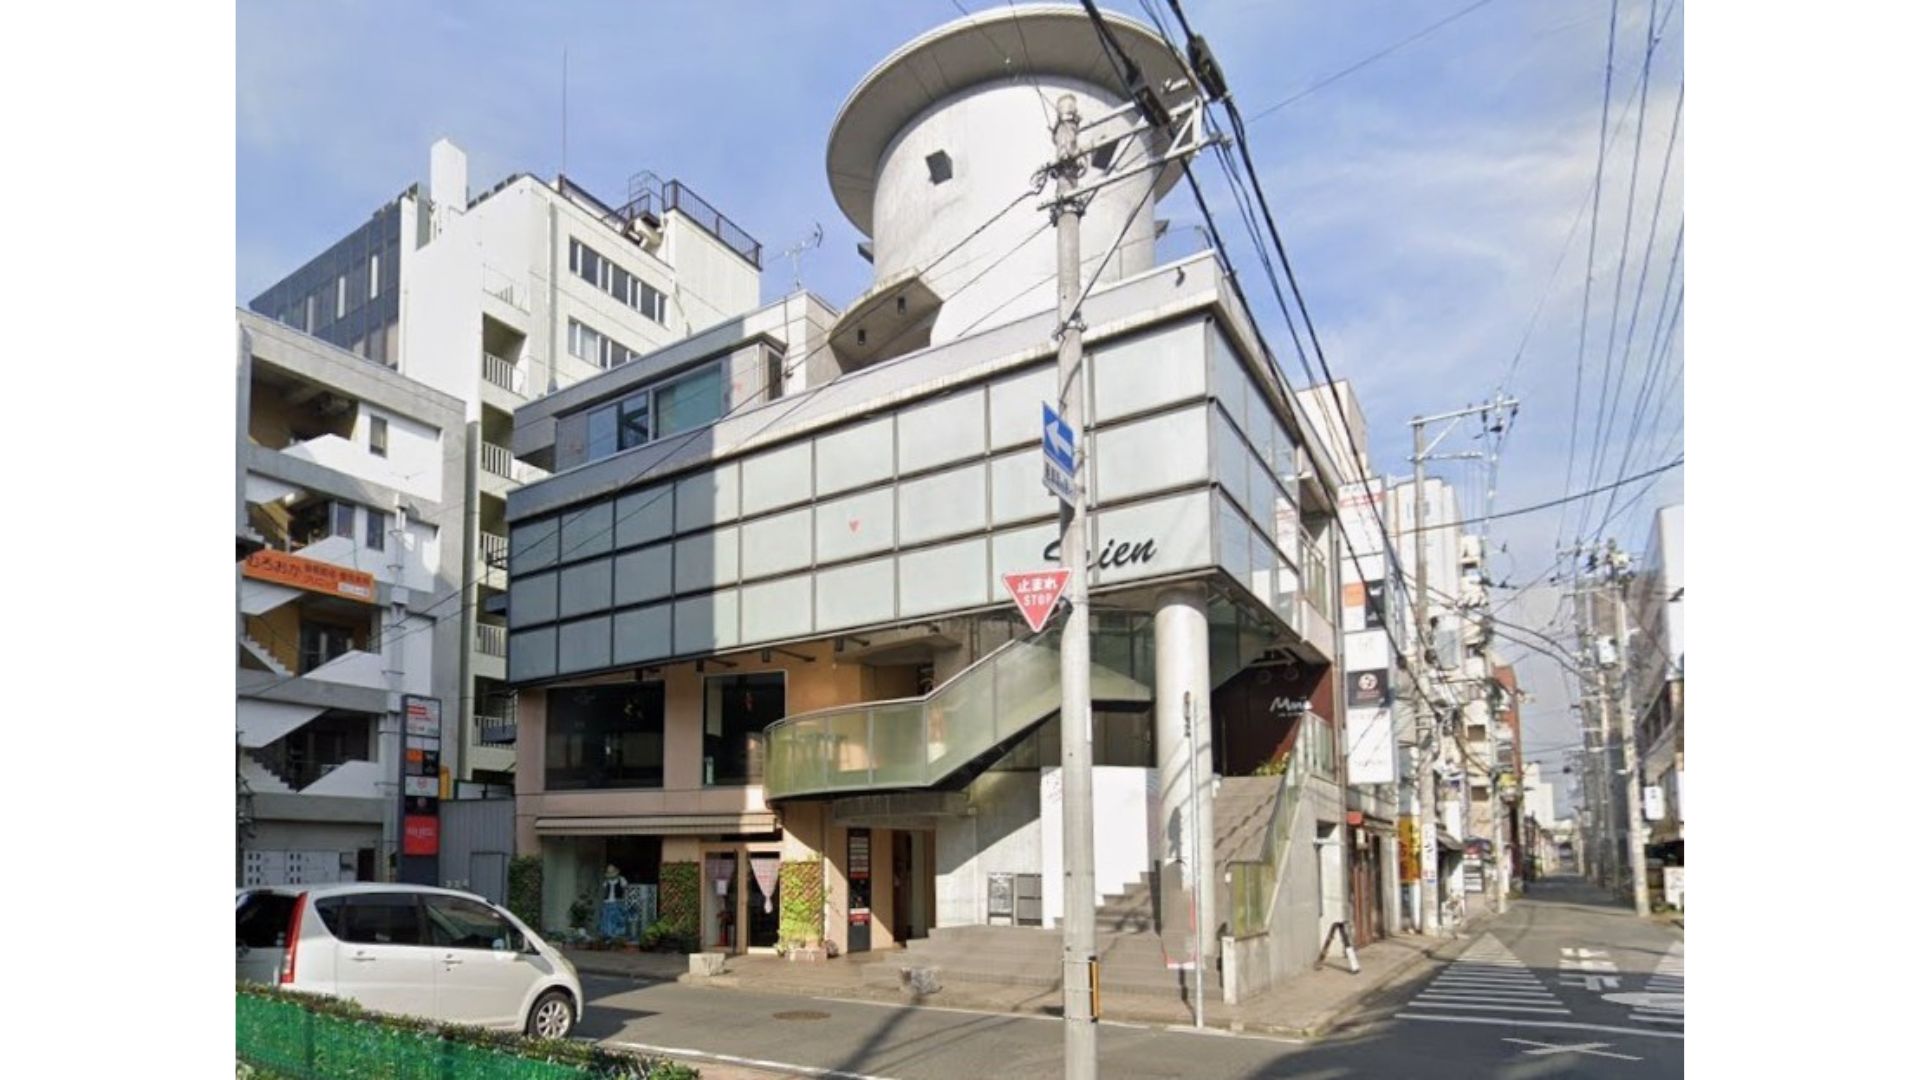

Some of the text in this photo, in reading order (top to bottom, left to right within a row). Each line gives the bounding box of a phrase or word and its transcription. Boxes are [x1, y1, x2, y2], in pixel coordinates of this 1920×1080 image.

[1017, 576, 1058, 593] 止まれ
[1023, 594, 1054, 607] STOP
